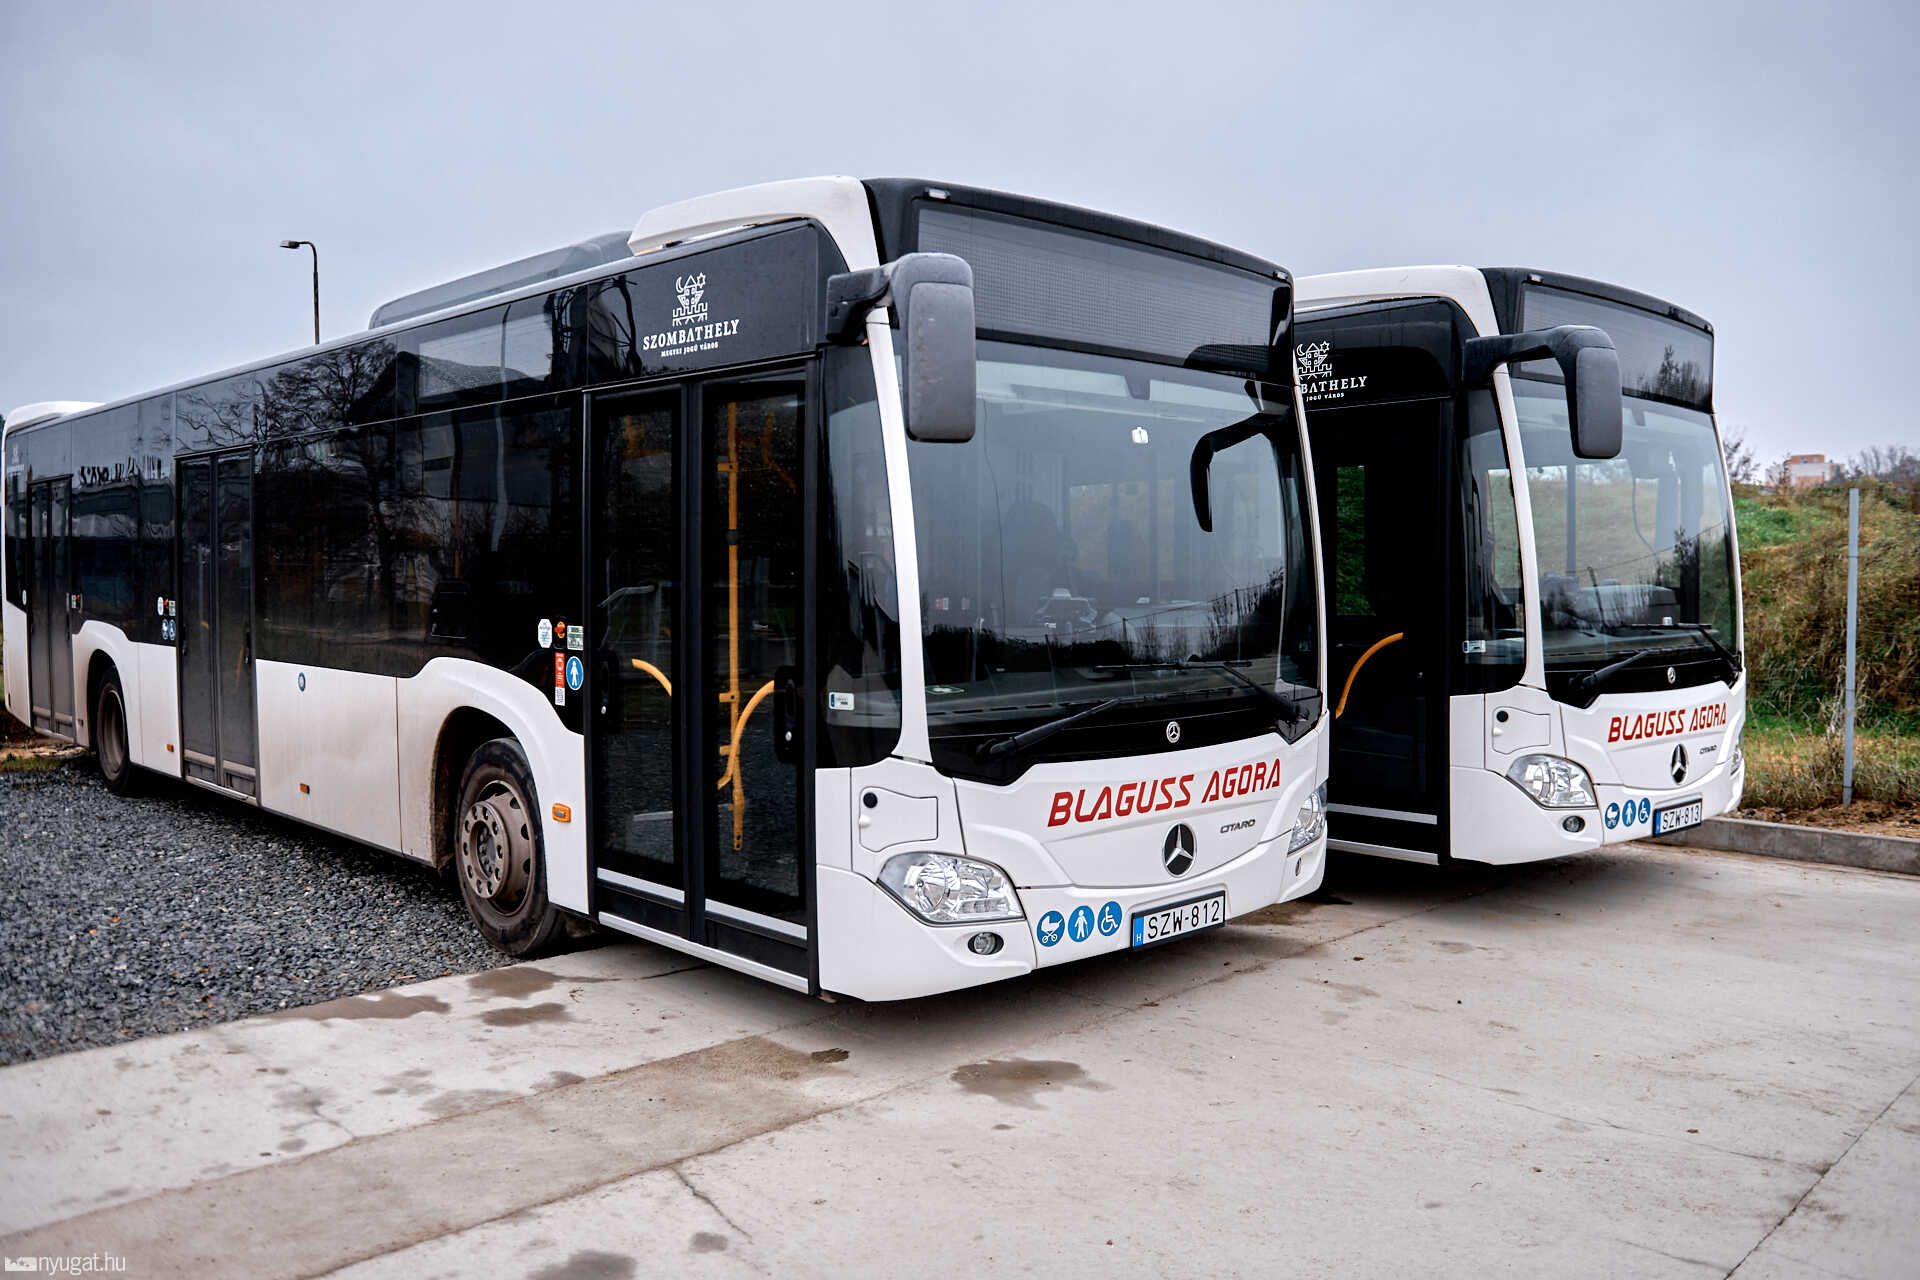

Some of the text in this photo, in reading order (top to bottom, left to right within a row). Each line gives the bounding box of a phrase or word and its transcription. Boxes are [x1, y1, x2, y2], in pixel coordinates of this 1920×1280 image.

[642, 319, 740, 351] SZOMBATHELY
[1301, 376, 1368, 394] BATHELY
[1608, 702, 1728, 743] BLAGUSS AGORA
[1048, 758, 1281, 827] BLAGUSS AGORA
[1662, 804, 1700, 830] SZW-813
[1147, 900, 1220, 939] SZW-812
